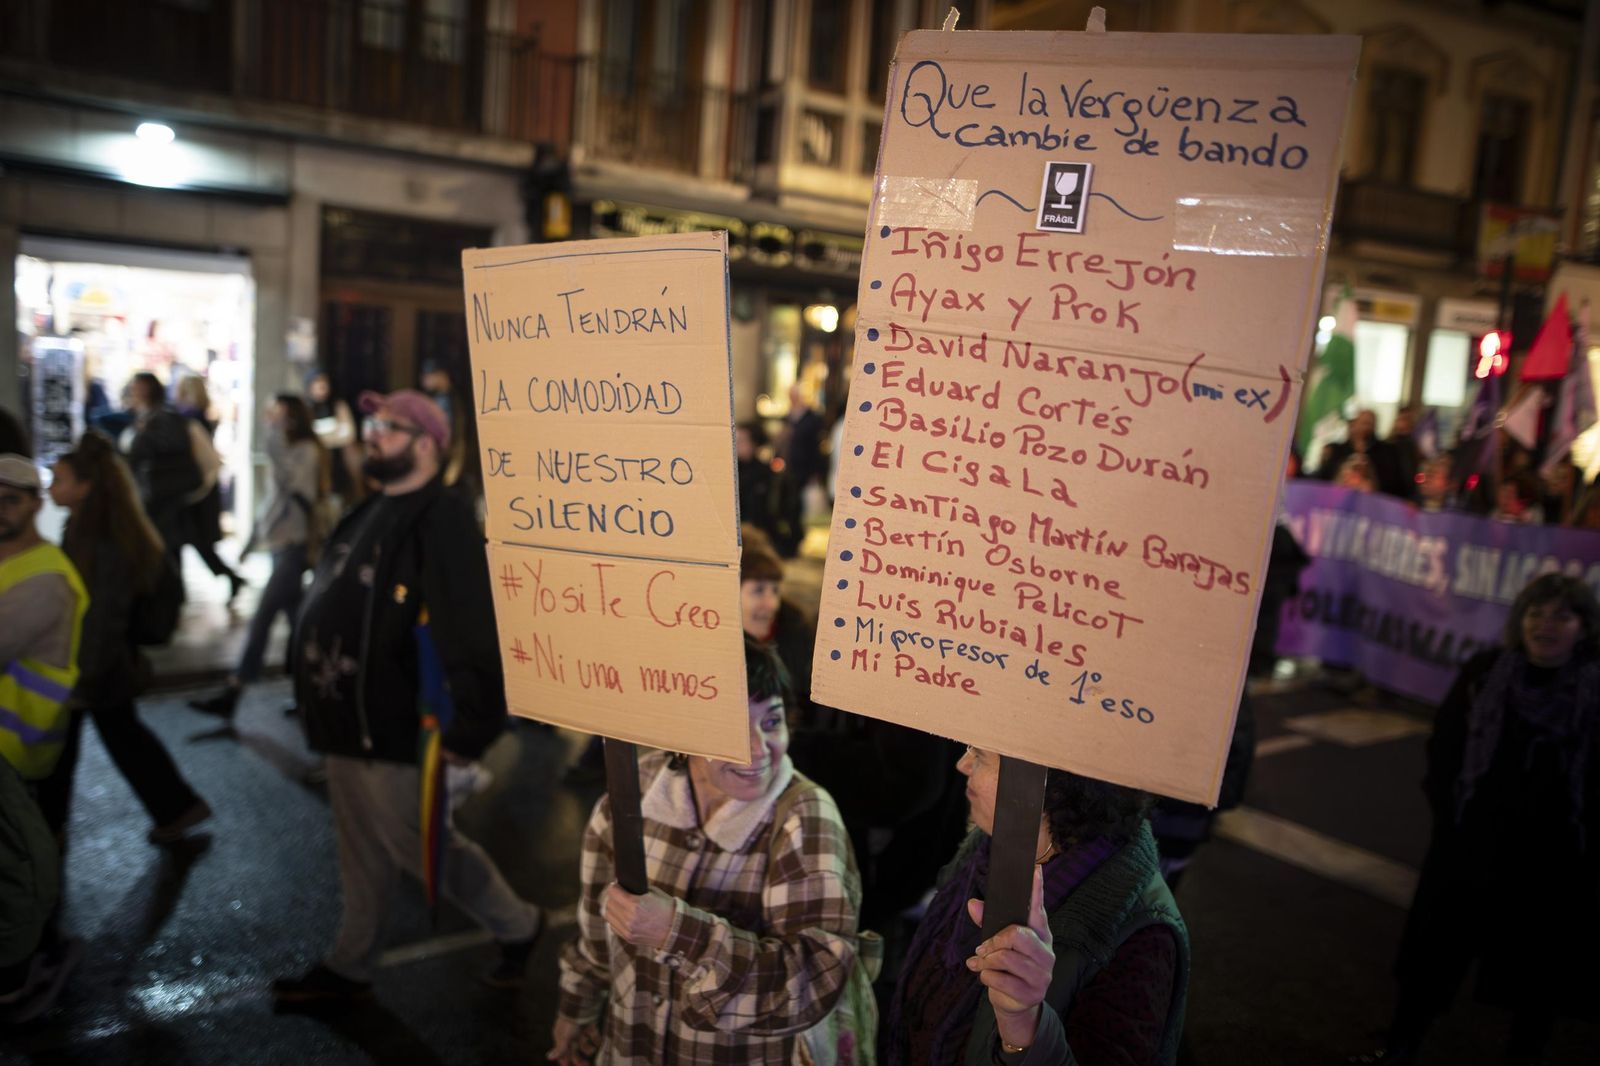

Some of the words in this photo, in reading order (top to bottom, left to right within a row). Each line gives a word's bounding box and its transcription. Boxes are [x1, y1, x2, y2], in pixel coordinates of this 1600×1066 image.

[902, 60, 996, 139] Que
[1019, 72, 1049, 118] la
[954, 122, 1099, 153] cambie
[1124, 138, 1160, 157] de
[1179, 127, 1309, 170] bando
[891, 226, 1005, 272] Iñigo
[890, 272, 985, 323] Ayax
[1007, 296, 1032, 332] y
[884, 323, 988, 363] David
[481, 369, 512, 415] LA
[881, 361, 1001, 410] Eduard
[487, 448, 516, 478] DE
[537, 448, 694, 486] NUESTRO
[871, 440, 904, 469] El
[1013, 424, 1088, 465] Pozo
[1096, 448, 1209, 489] Durán
[858, 548, 997, 603] Dominique
[863, 516, 965, 557] Bertín
[985, 543, 1127, 600] Osborne
[646, 570, 721, 630] Creo
[856, 580, 922, 620] Luis
[934, 599, 1088, 667] Rubiales
[577, 659, 624, 694] una
[639, 665, 719, 700] menos
[851, 648, 881, 673] Mi
[894, 653, 981, 696] Padre
[855, 616, 883, 644] Mi
[1024, 658, 1051, 686] de
[1100, 697, 1155, 724] eso
